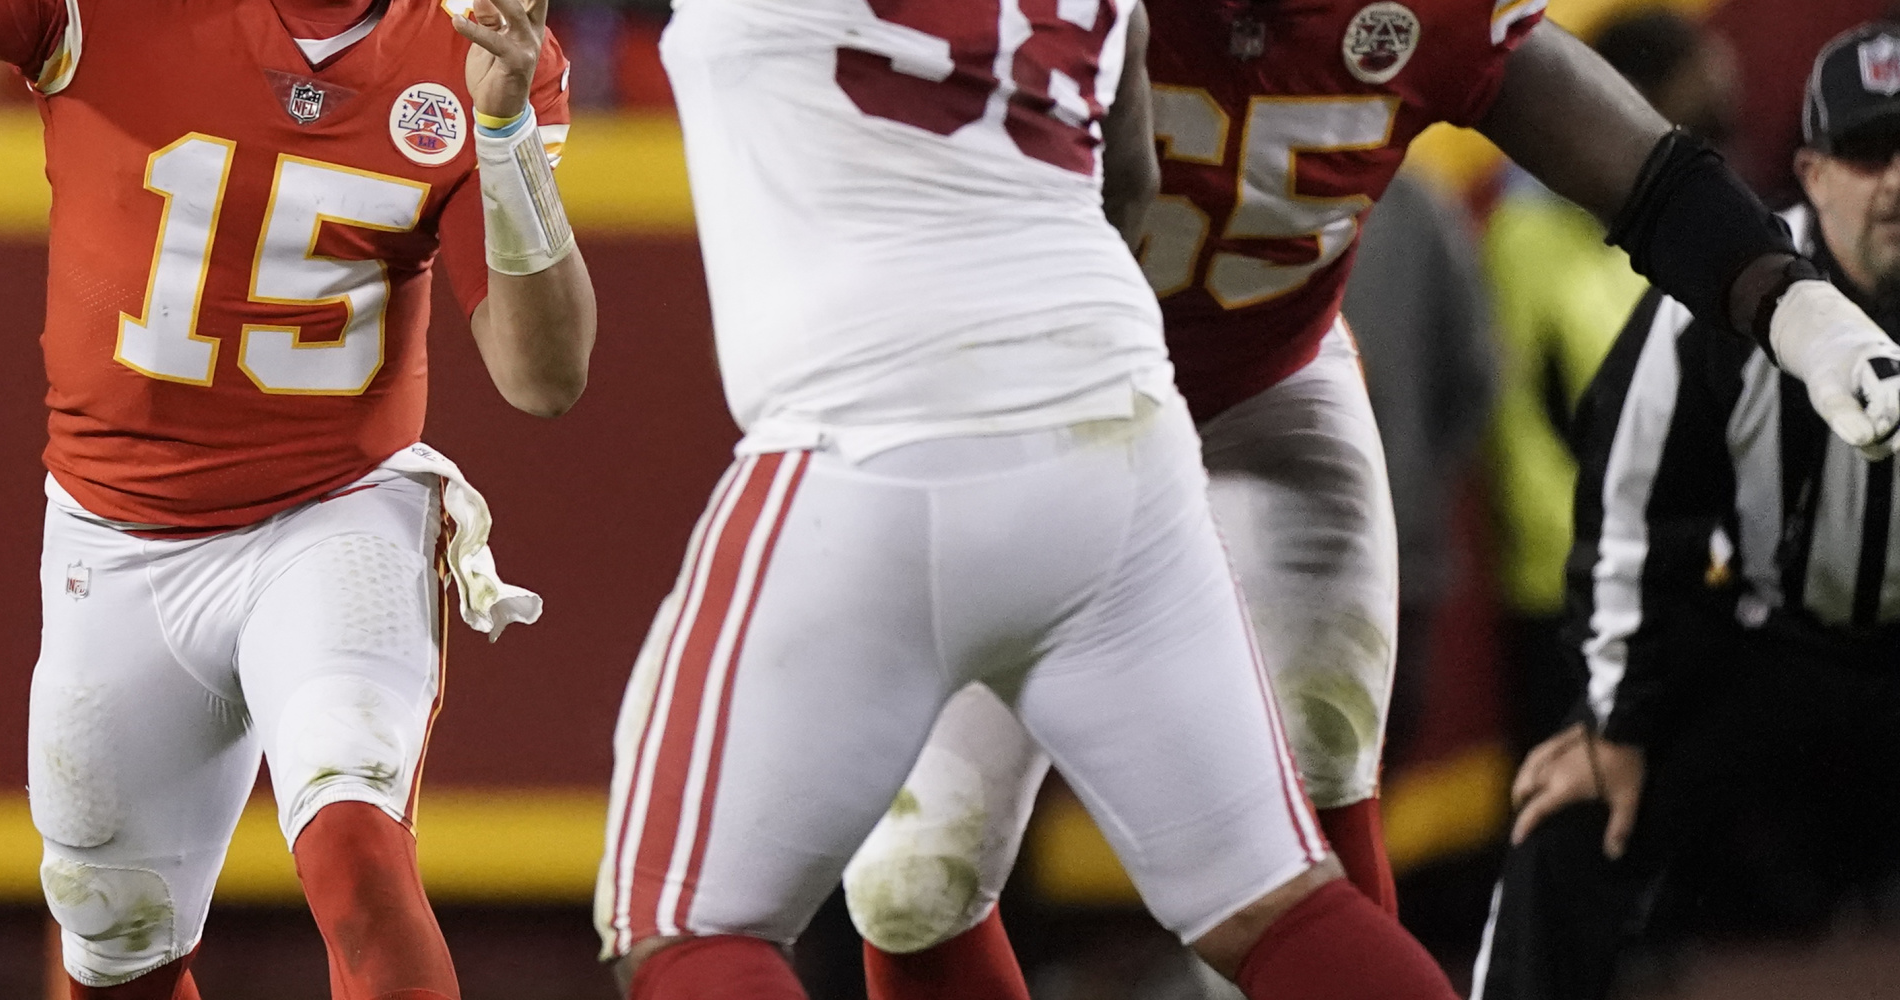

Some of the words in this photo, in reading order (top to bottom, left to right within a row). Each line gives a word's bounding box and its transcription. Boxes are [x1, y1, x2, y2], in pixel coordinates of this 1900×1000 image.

[293, 99, 315, 116] NFL
[1136, 82, 1401, 310] 65
[113, 131, 432, 396] 15
